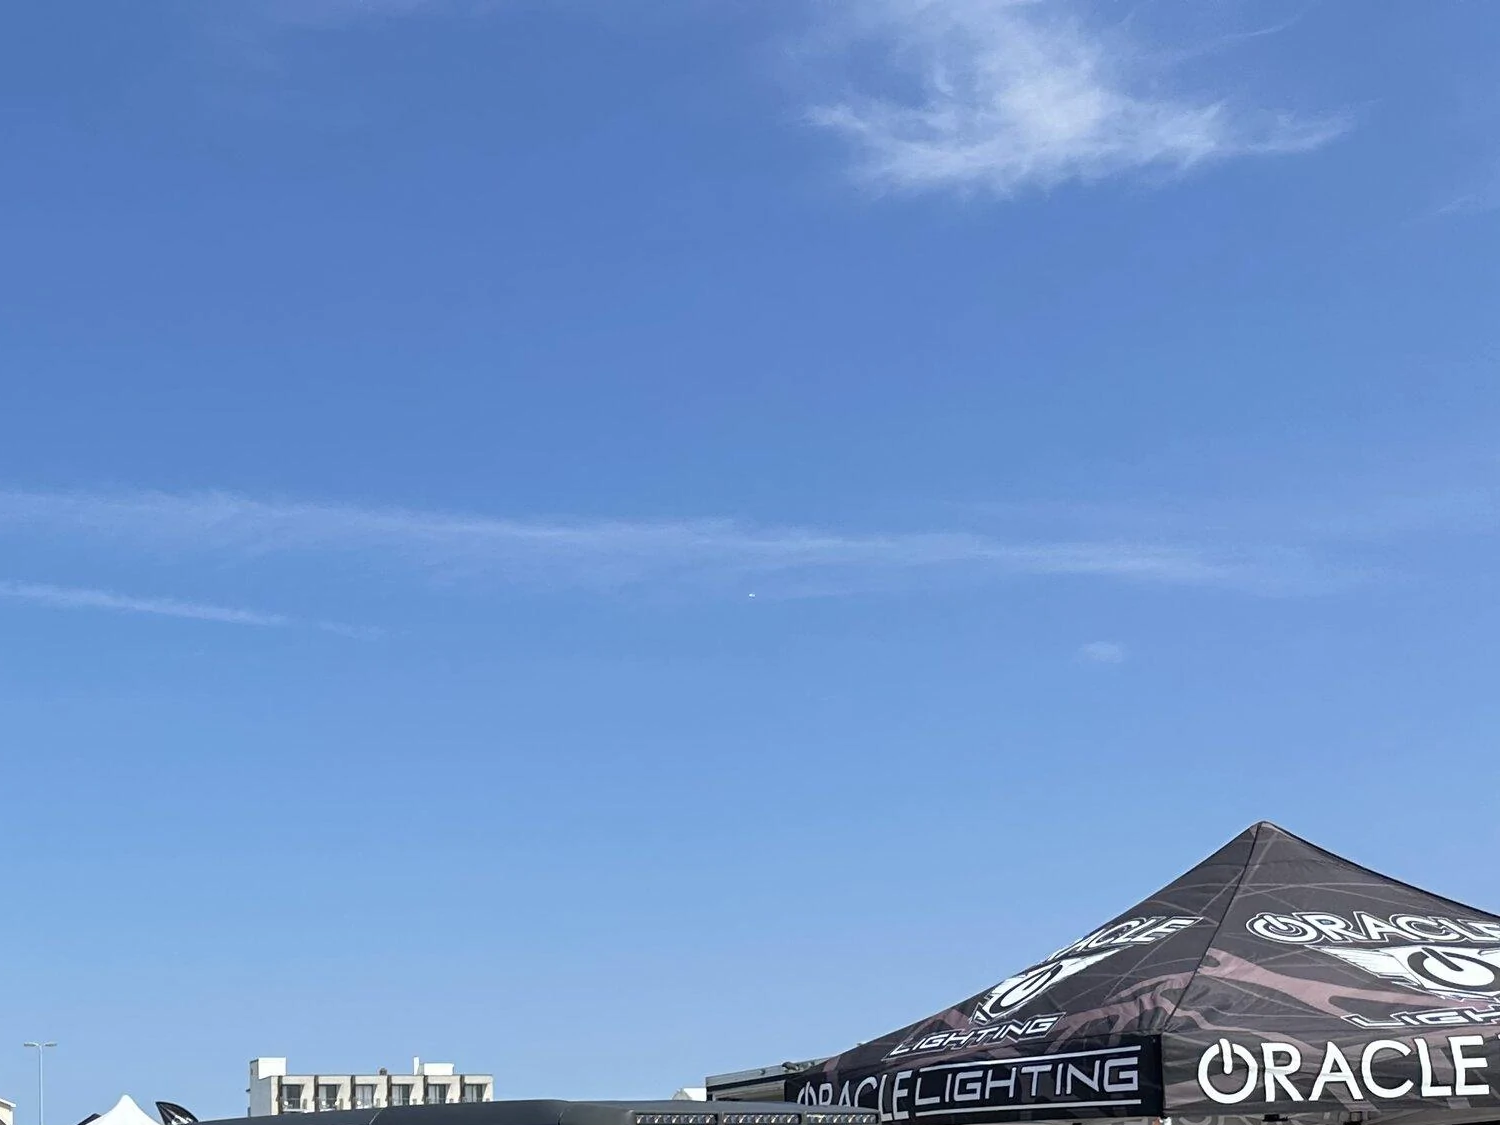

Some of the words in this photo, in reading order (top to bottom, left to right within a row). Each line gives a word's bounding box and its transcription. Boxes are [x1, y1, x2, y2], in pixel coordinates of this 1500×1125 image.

[886, 1014, 1062, 1058] LIGHTING
[915, 1056, 1139, 1107] LIGHTING
[1197, 1038, 1490, 1104] ORACLE
